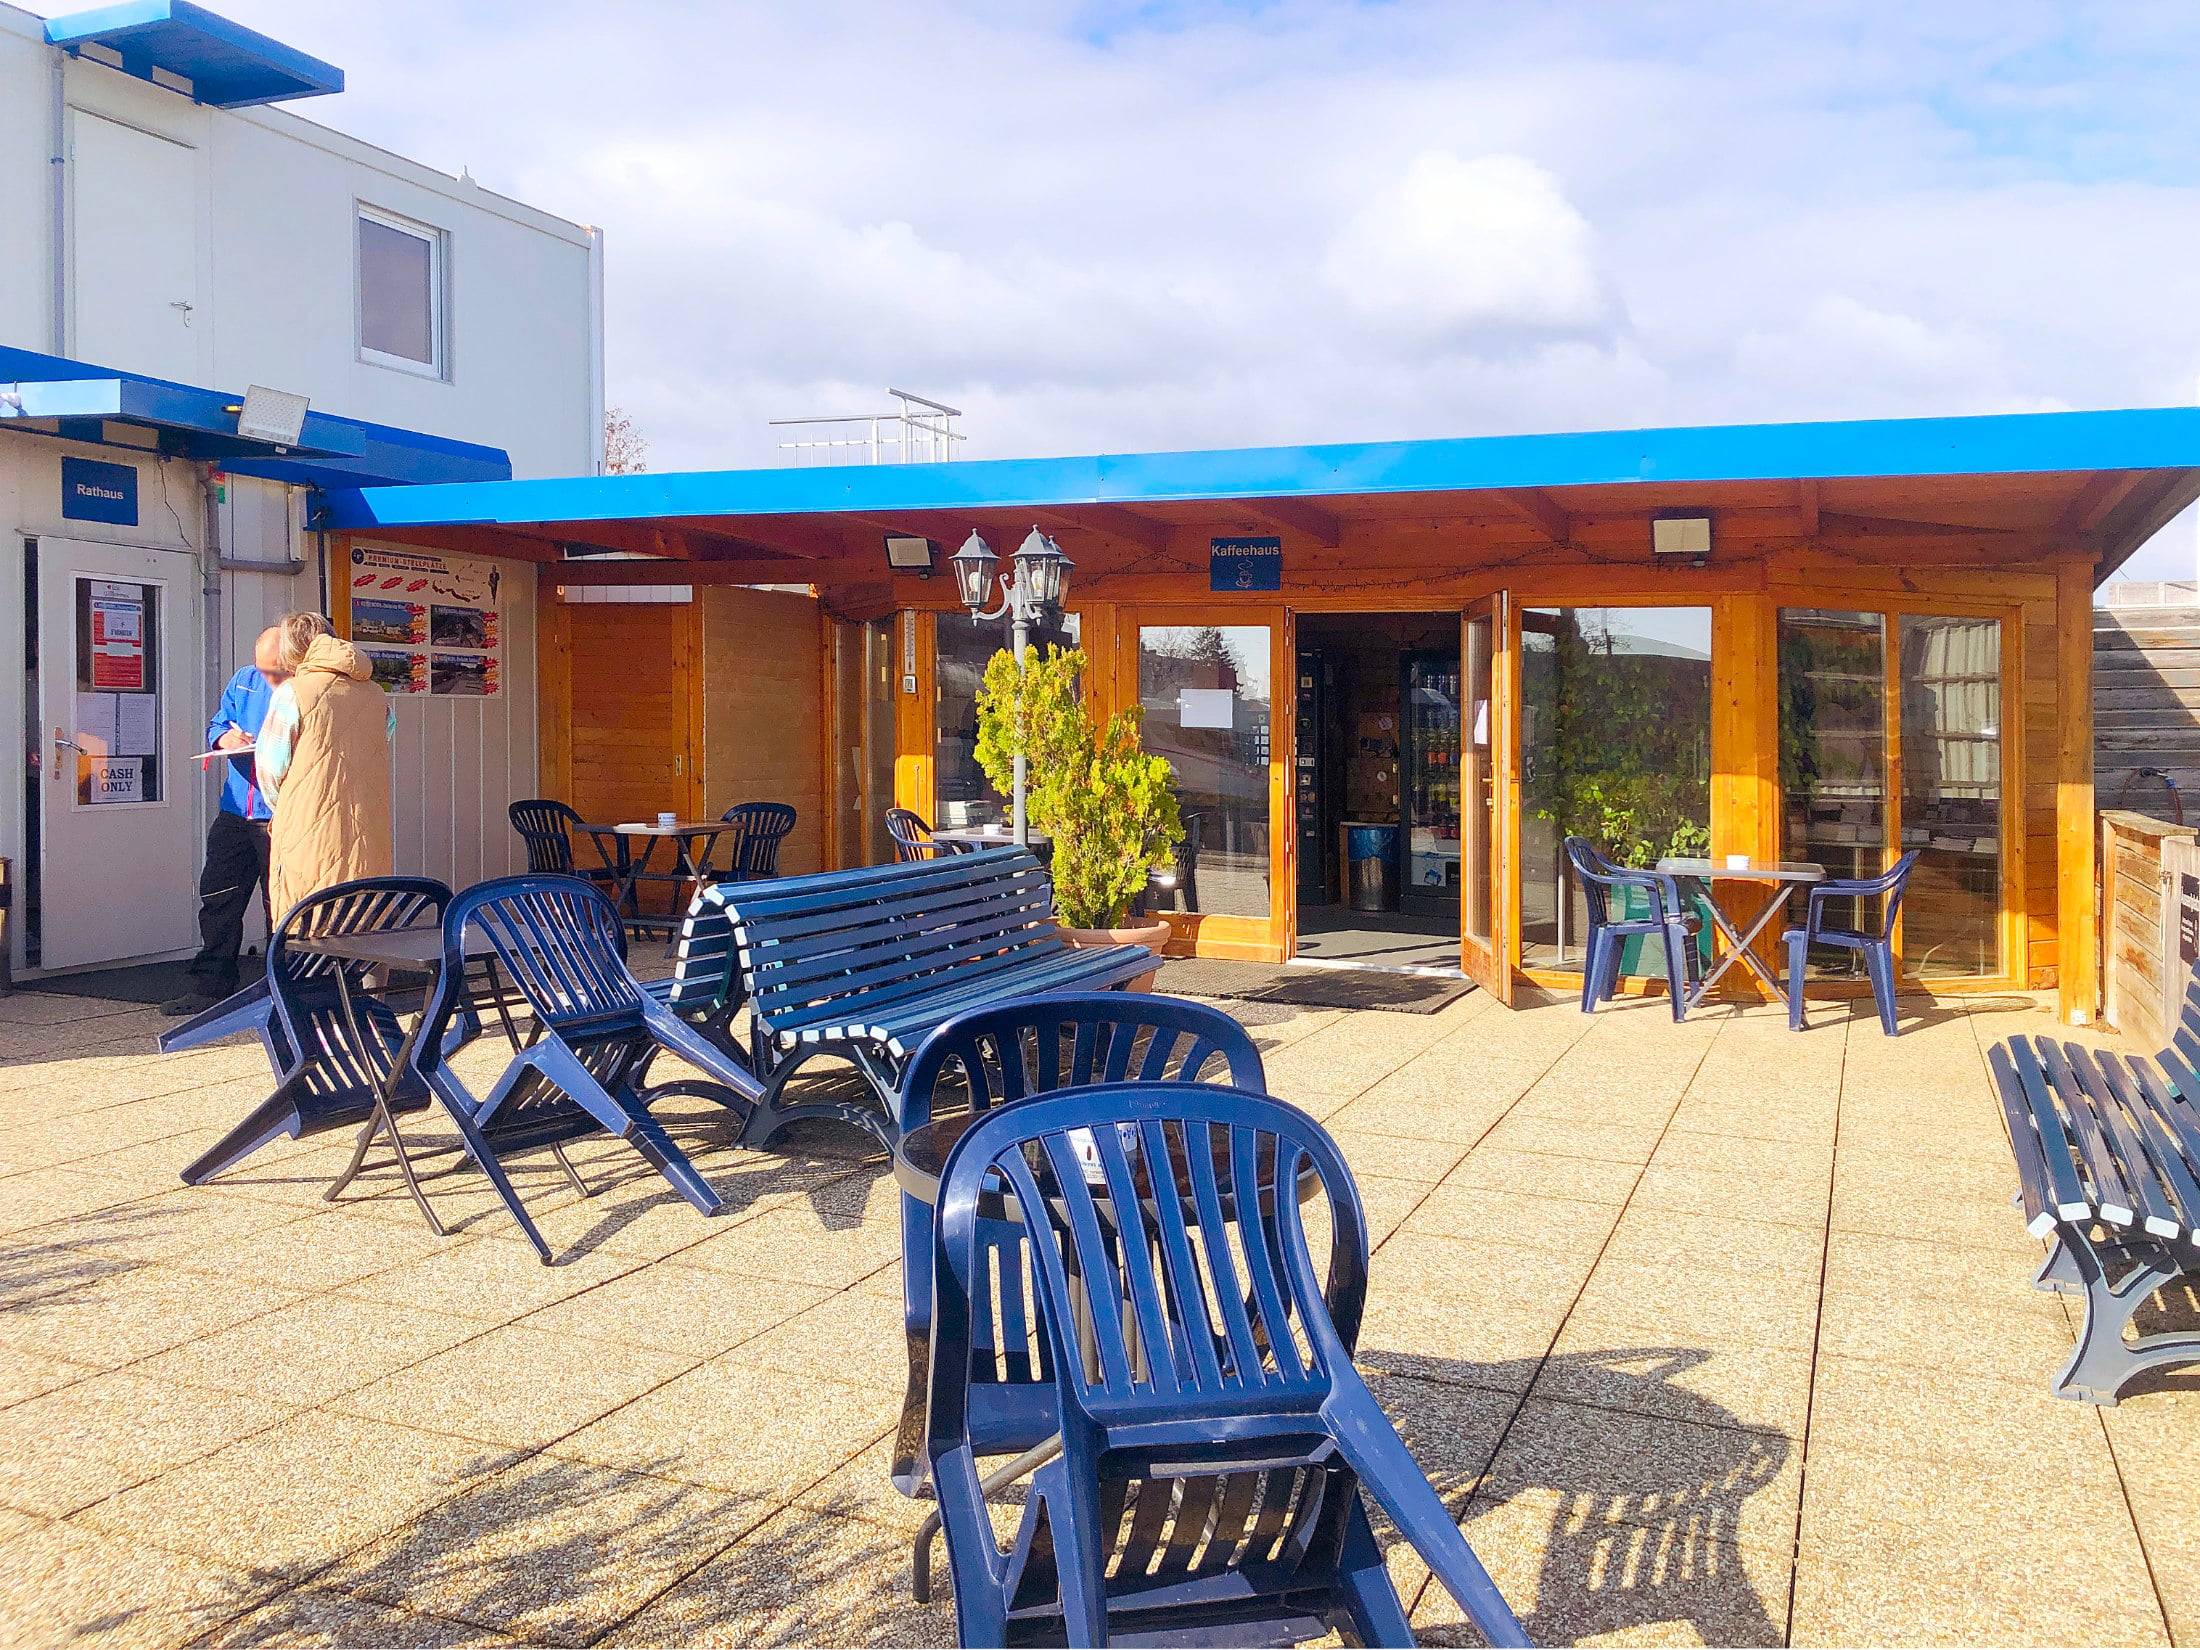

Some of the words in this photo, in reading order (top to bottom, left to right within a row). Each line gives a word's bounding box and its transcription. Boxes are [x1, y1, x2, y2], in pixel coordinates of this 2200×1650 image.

[76, 483, 124, 500] Rathaus
[1211, 544, 1279, 556] Kaffeehaus
[100, 768, 134, 779] CASH
[101, 781, 133, 792] ONLY
